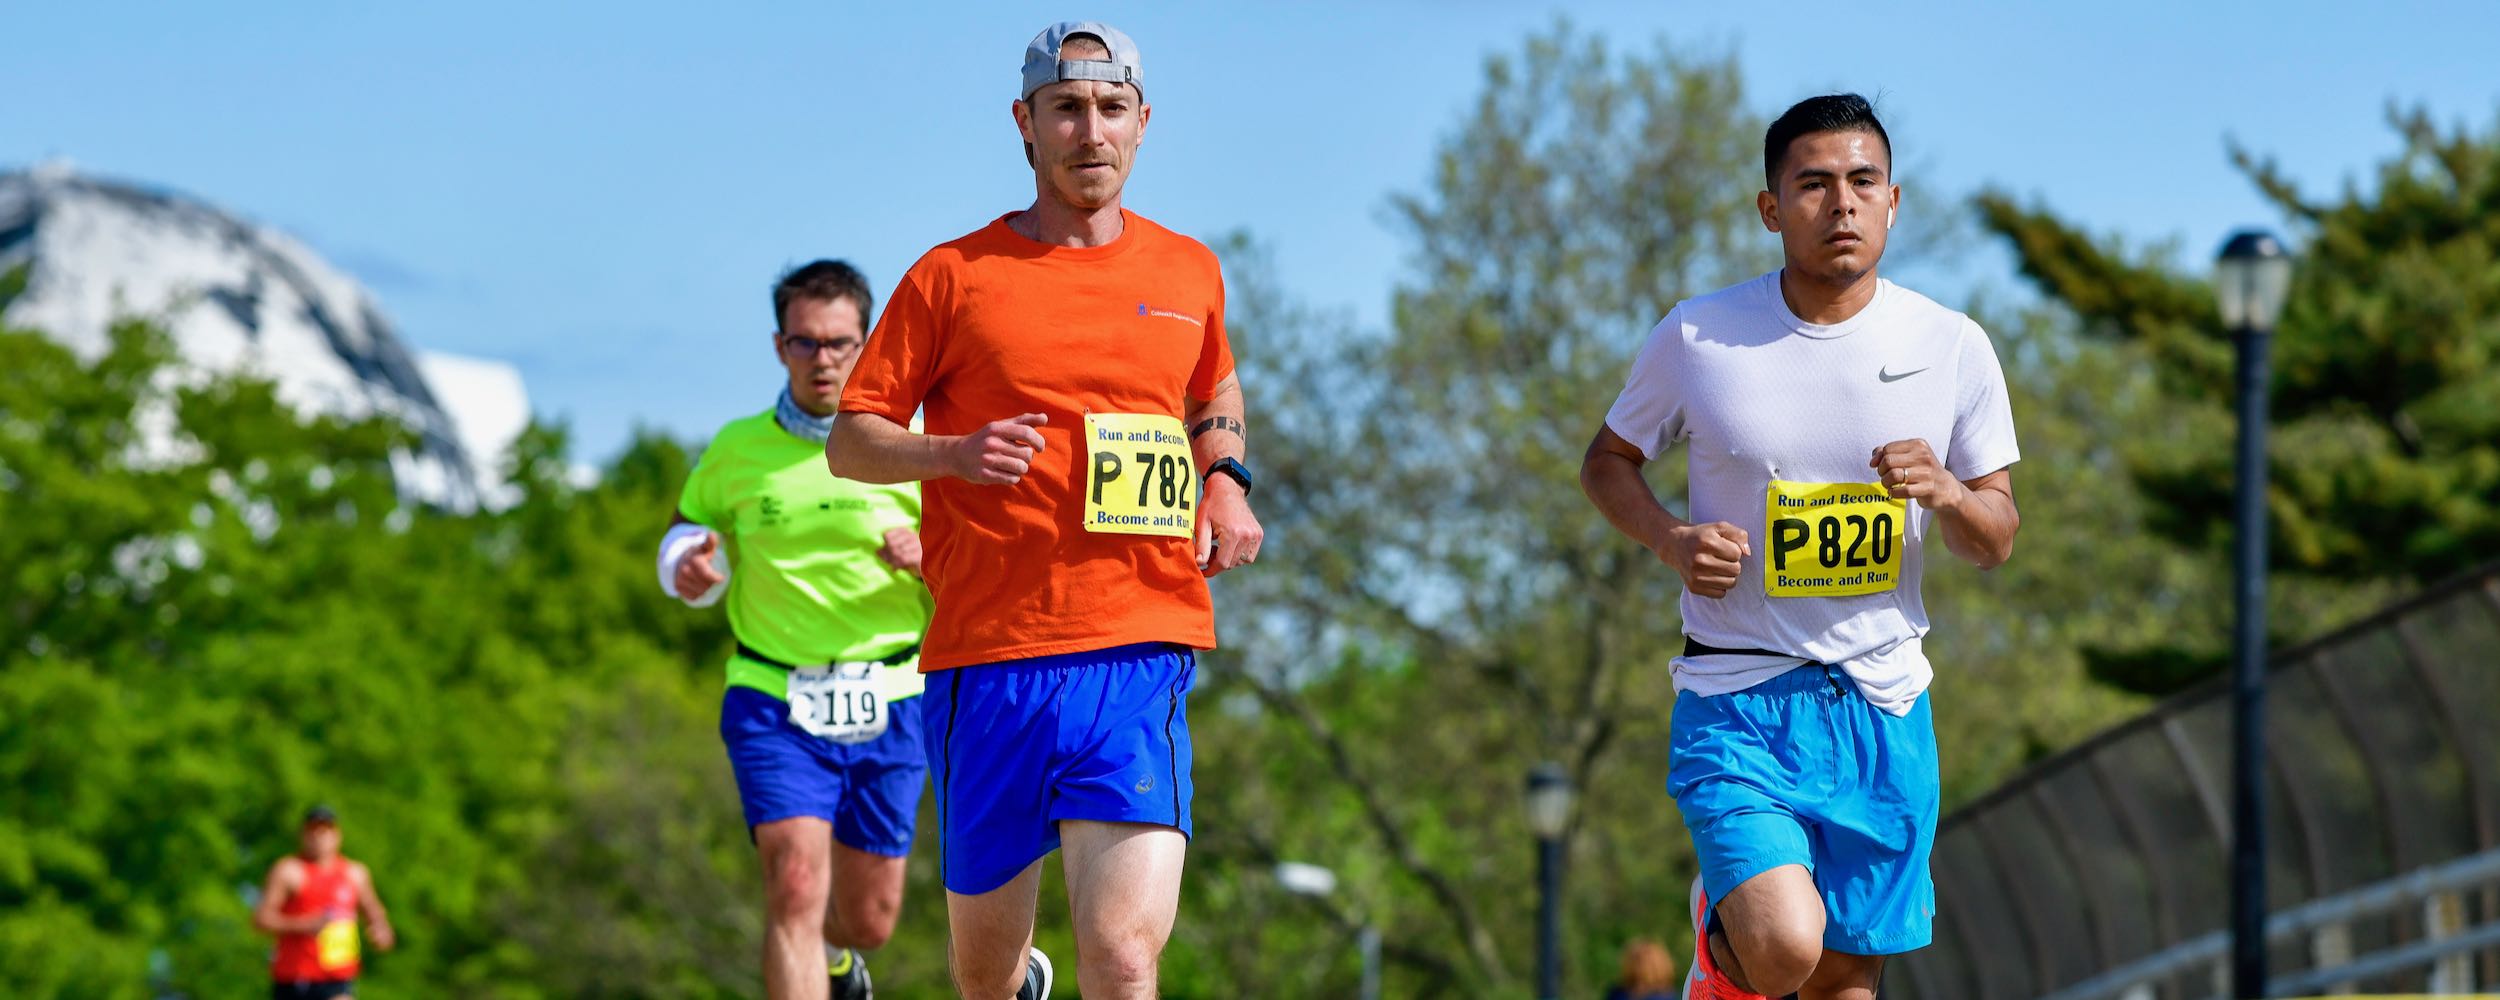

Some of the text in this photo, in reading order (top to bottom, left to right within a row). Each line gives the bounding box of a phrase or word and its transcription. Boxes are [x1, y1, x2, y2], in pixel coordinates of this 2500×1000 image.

[1098, 428, 1123, 441] Run
[1128, 430, 1150, 443] and
[1092, 451, 1190, 511] P 782
[1778, 495, 1805, 507] Run
[1810, 495, 1835, 507] and
[1097, 511, 1149, 525] Become
[1153, 514, 1173, 526] and
[1778, 571, 1889, 587] Become and Run
